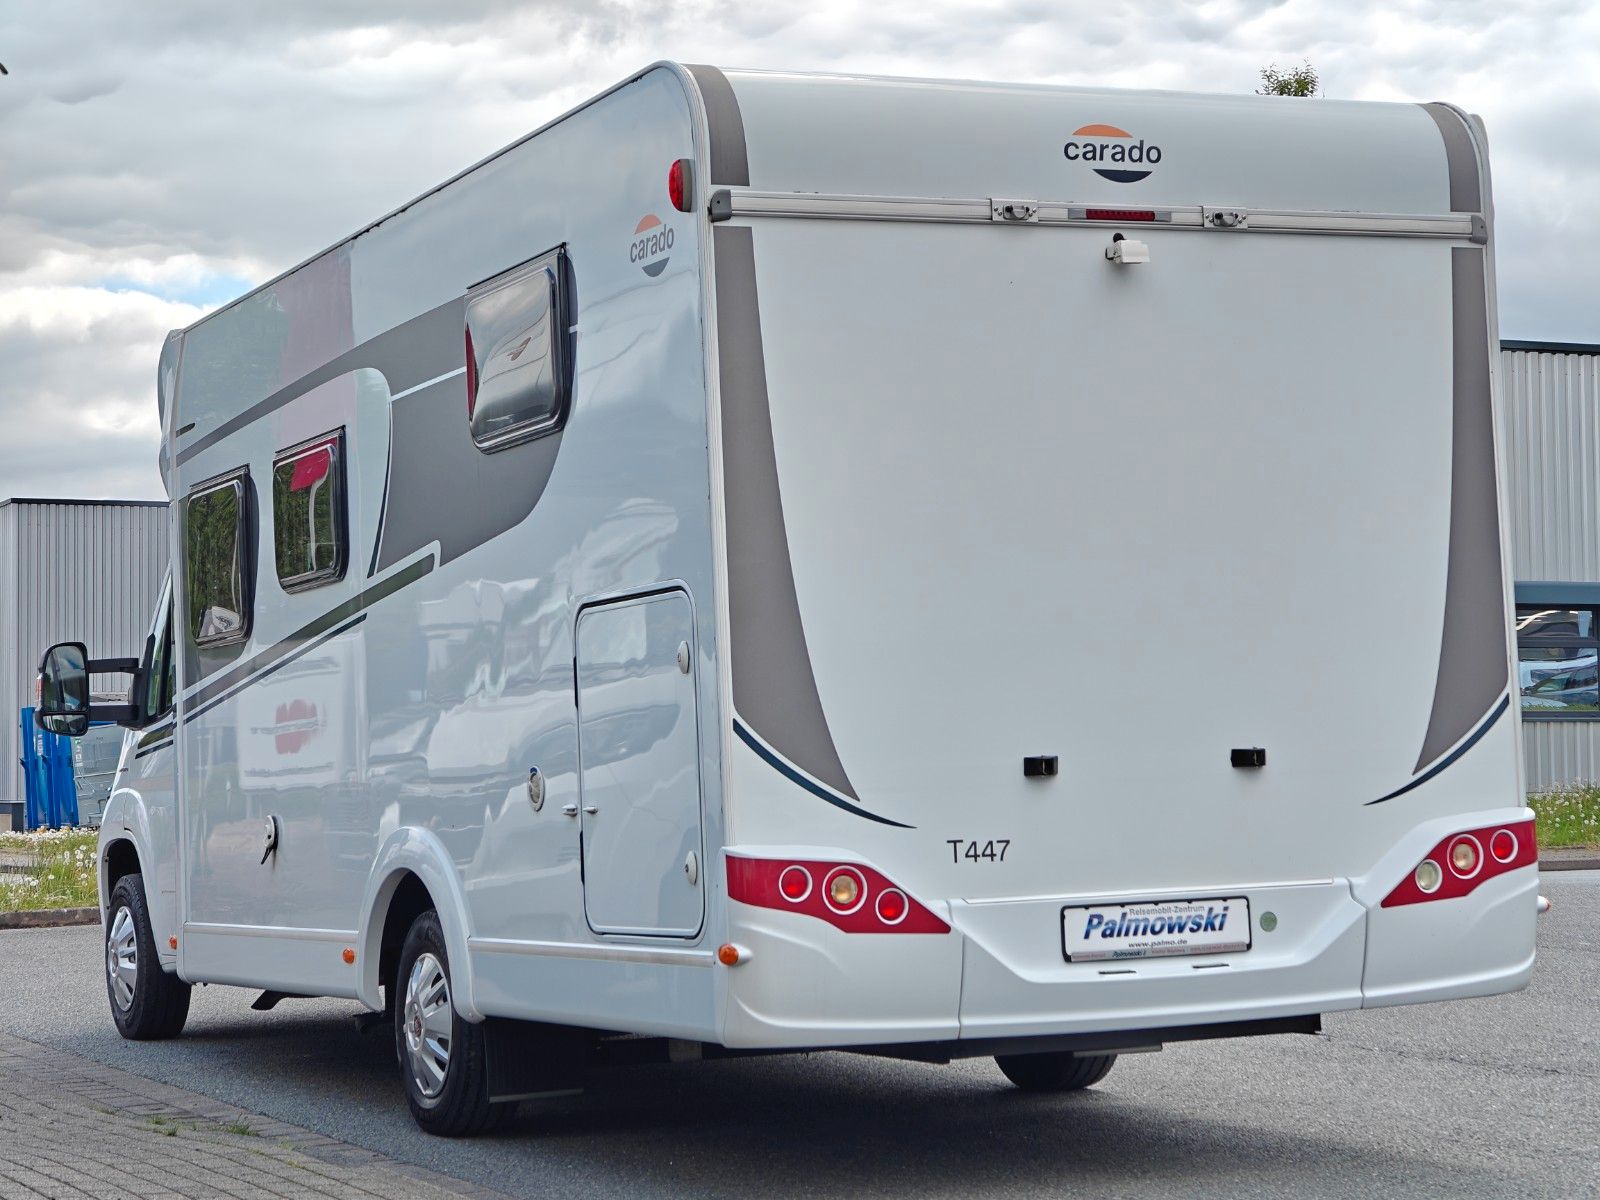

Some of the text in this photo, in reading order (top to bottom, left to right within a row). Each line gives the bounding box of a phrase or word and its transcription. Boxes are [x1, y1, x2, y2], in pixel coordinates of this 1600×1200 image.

[1063, 139, 1162, 164] carado
[630, 223, 674, 263] carado
[946, 839, 1010, 864] T447
[1083, 906, 1229, 940] Palmowski
